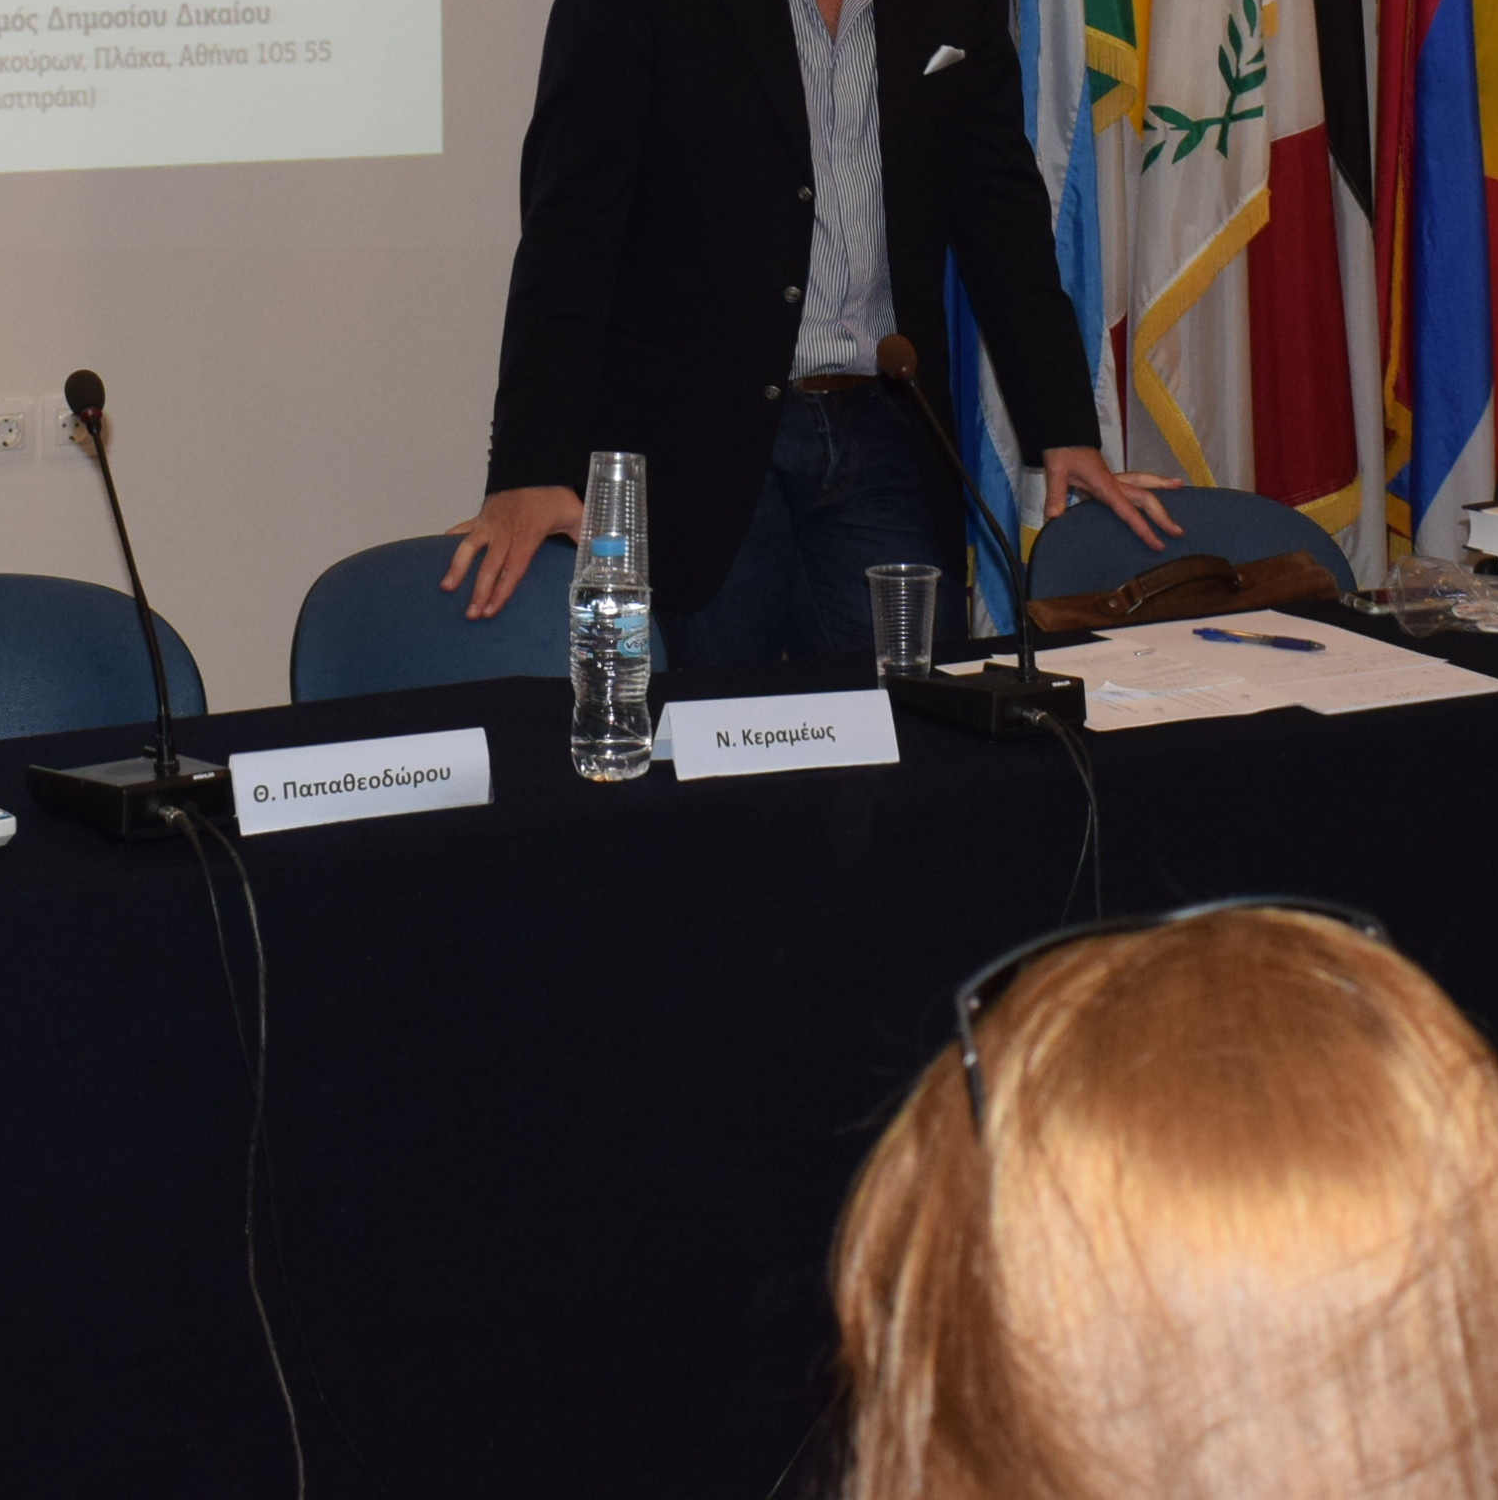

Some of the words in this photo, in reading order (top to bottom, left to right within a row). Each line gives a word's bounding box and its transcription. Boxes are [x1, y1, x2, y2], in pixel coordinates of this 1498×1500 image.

[48, 4, 166, 37] Δημοσίου
[175, 1, 270, 30] Δικαίου
[94, 45, 171, 72] Πλάκα,
[178, 42, 249, 67] Αθήνα
[256, 42, 297, 66] 105
[305, 40, 332, 63] 55
[716, 731, 737, 748] Ν.
[742, 721, 835, 747] Κεραμέως
[252, 783, 276, 804] Θ.
[283, 764, 452, 801] Παπαθεοδώρου
